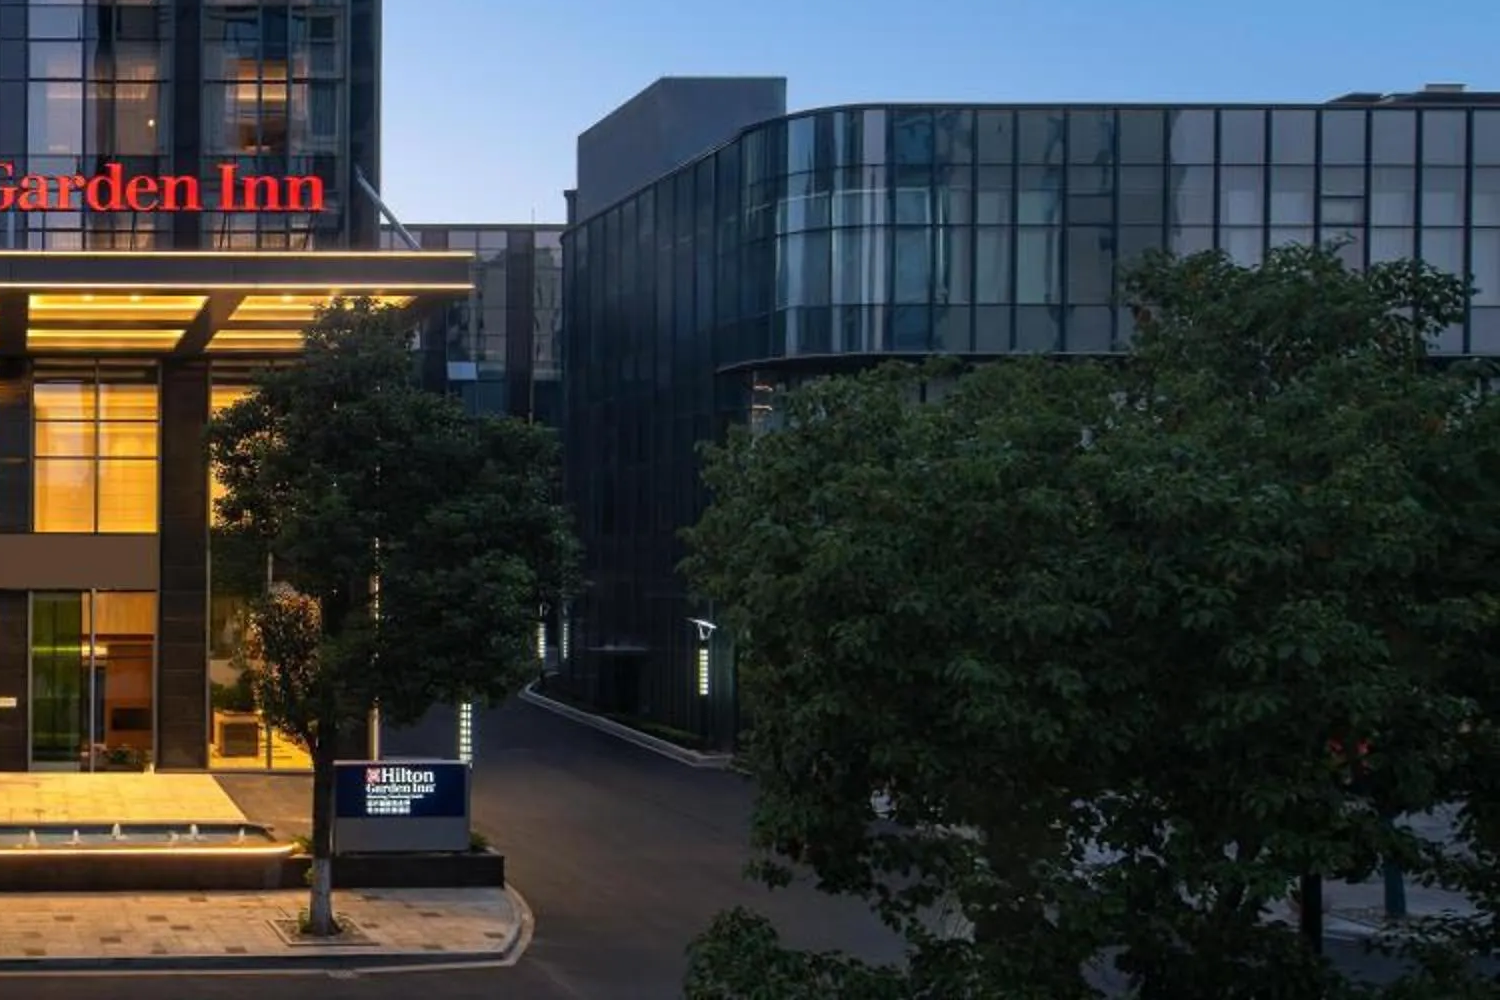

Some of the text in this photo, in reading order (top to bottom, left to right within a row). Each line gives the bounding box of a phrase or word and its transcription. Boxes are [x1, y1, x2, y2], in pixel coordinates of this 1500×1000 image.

[217, 163, 325, 211] Inn
[382, 767, 435, 783] Hilton
[366, 783, 435, 793] Garden Inn
